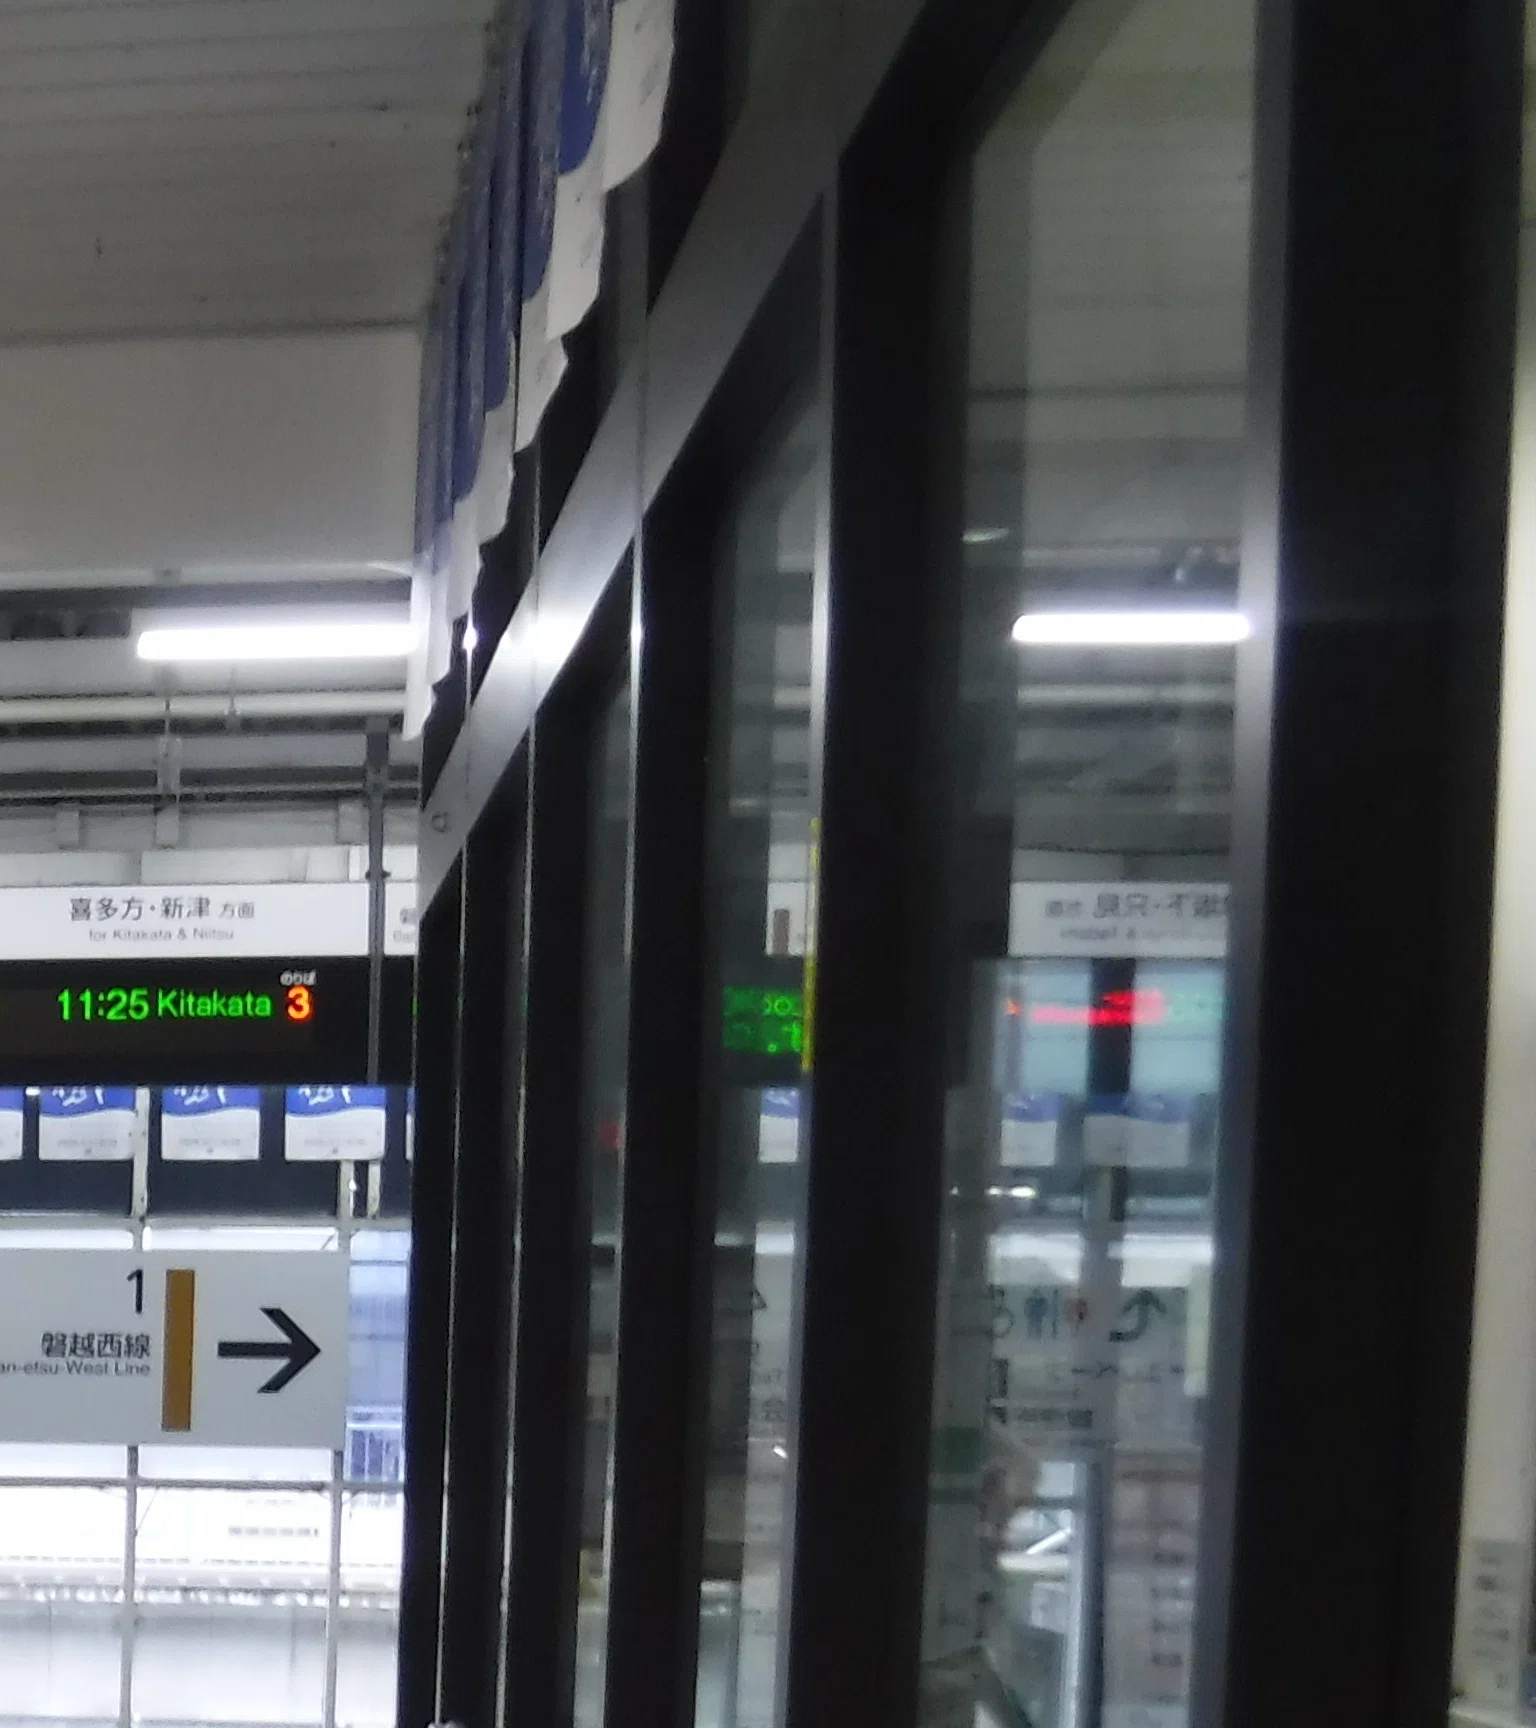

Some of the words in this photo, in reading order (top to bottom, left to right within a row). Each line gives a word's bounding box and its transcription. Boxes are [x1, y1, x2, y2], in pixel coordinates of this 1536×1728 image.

[70, 897, 210, 921] 喜多方・新津
[58, 988, 149, 1021] 11:25
[157, 989, 272, 1018] Kitakata
[288, 985, 310, 1019] 3
[127, 1269, 143, 1314] 1
[41, 1332, 150, 1359] 磐越西線
[115, 1361, 150, 1376] Line
